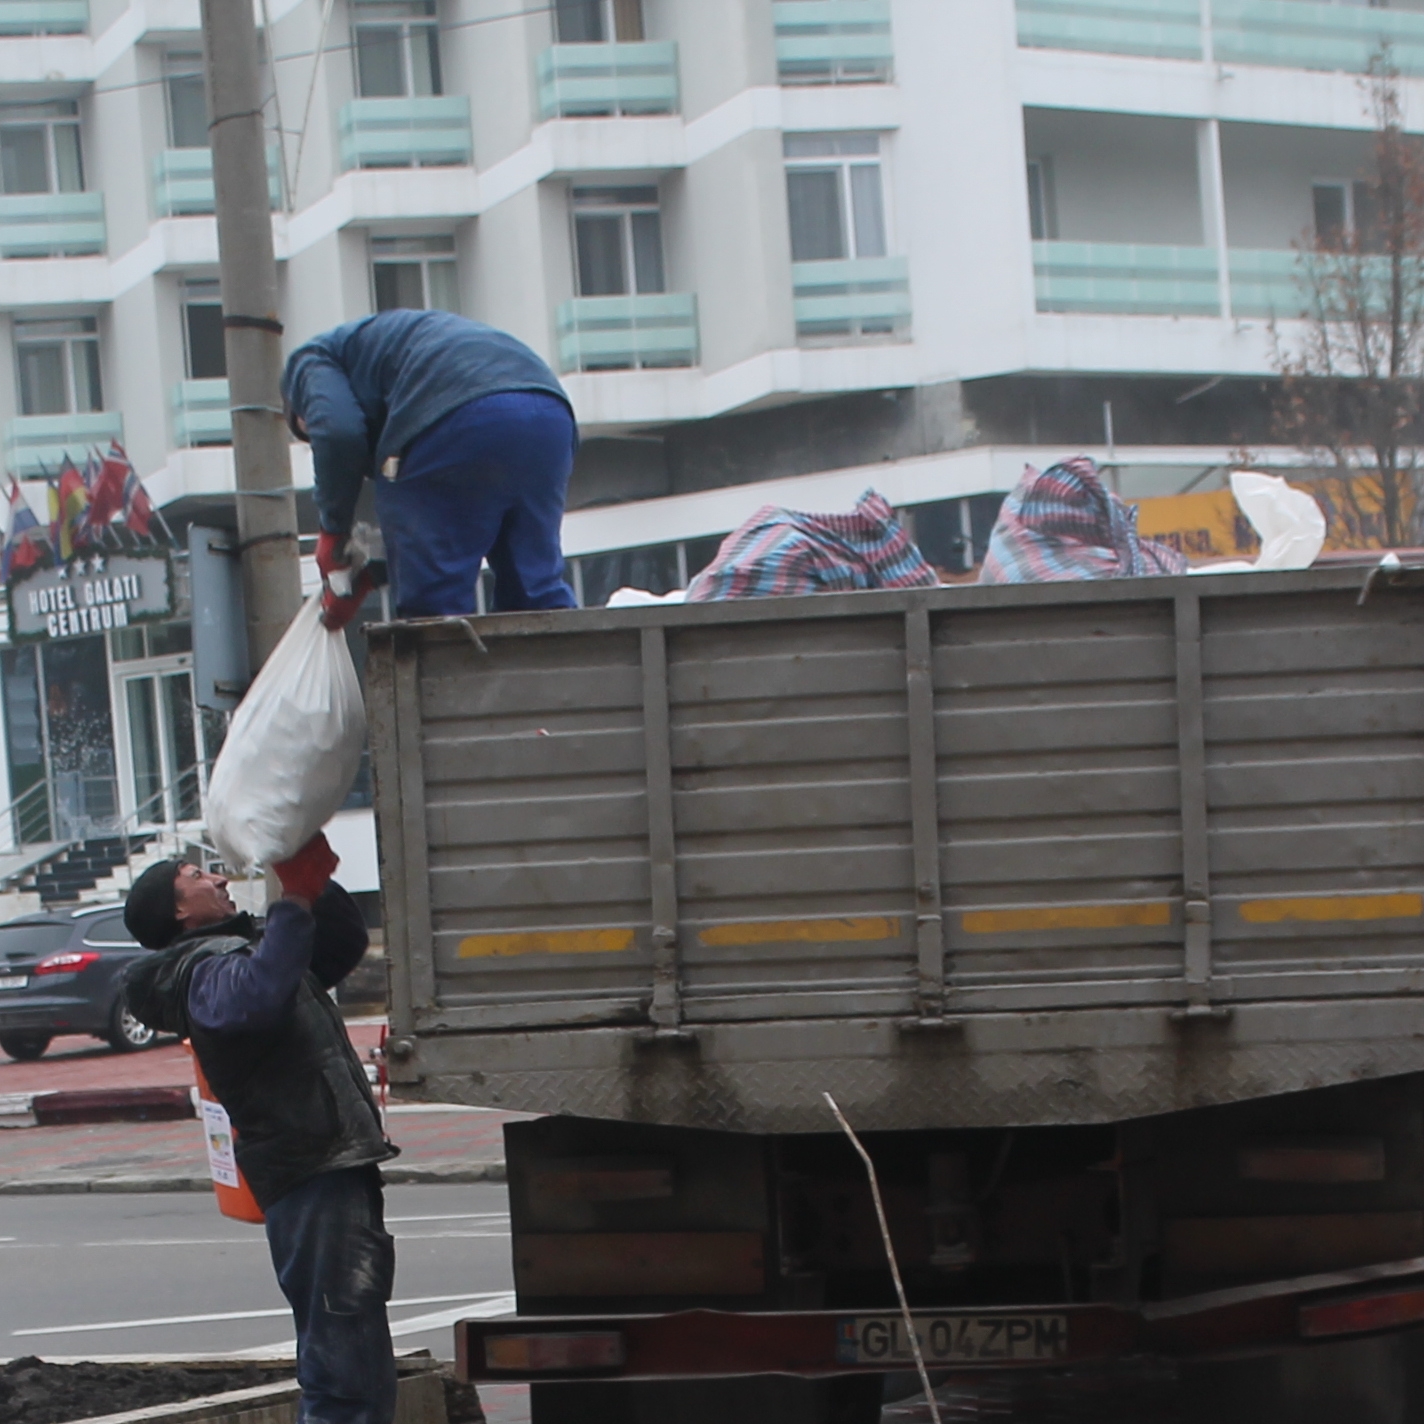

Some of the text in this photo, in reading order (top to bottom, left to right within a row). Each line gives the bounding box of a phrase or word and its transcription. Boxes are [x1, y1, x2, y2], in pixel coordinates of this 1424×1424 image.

[28, 574, 139, 615] HOTEL GALATI
[46, 602, 128, 638] CENTRUM
